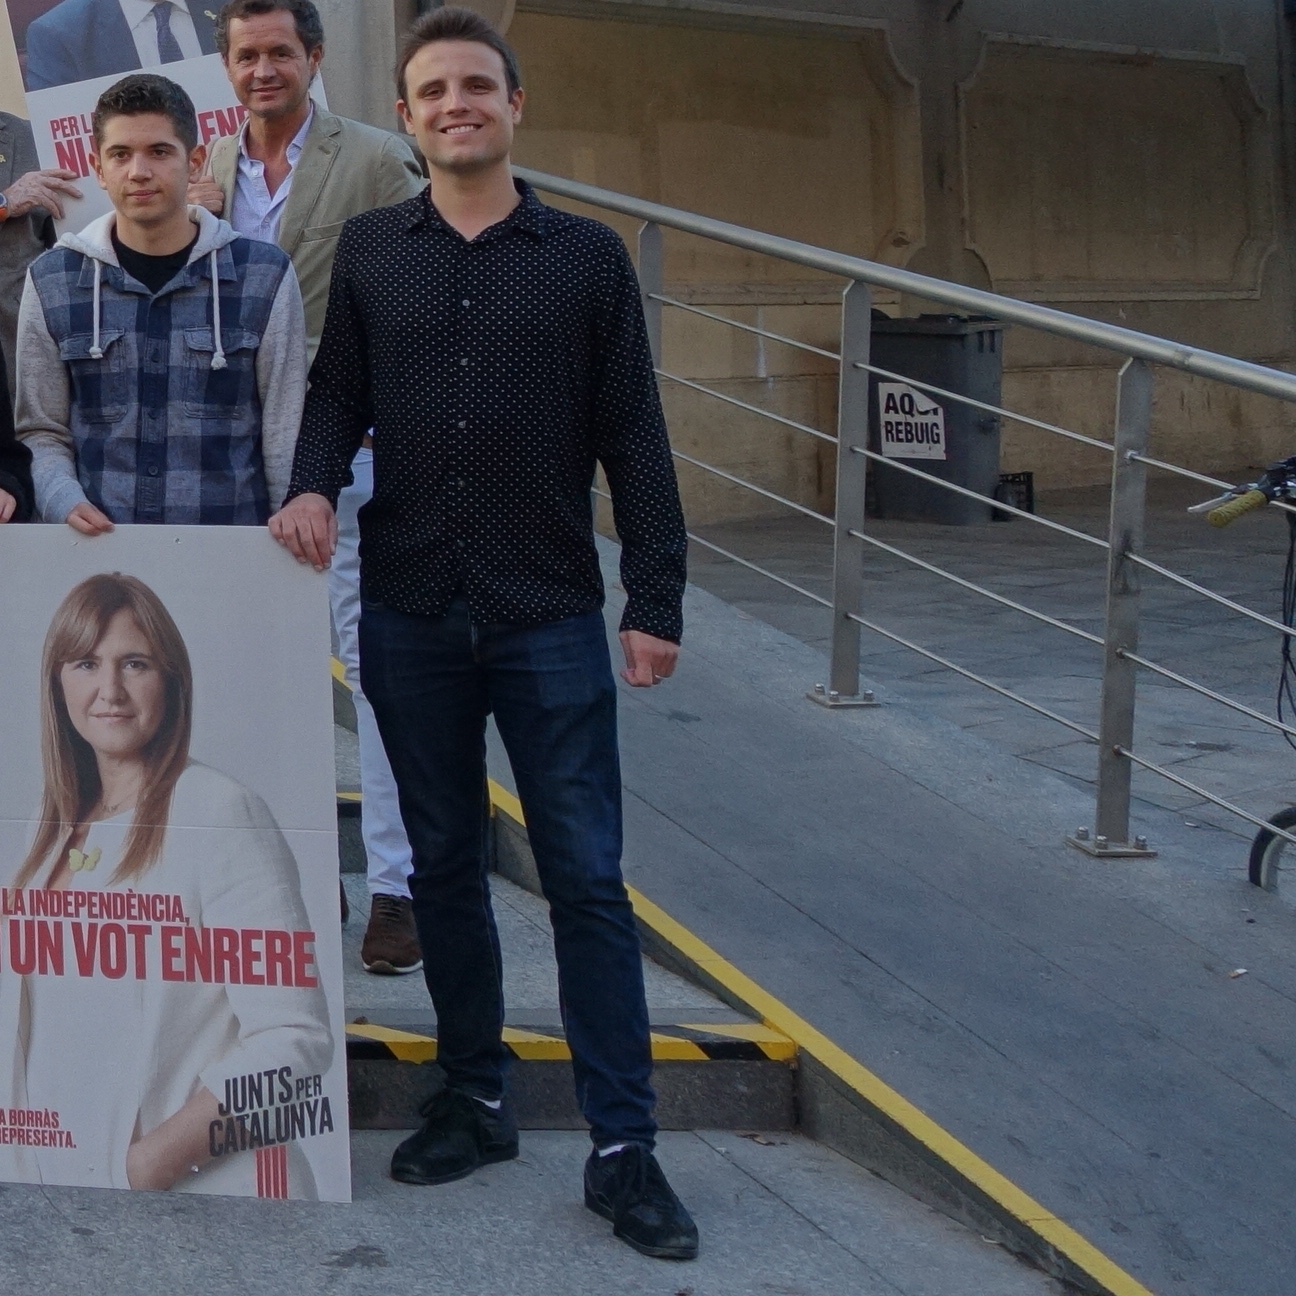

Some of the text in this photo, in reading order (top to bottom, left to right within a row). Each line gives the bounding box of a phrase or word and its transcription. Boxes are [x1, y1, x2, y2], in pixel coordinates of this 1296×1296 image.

[49, 115, 80, 140] PER
[54, 137, 90, 178] NI
[885, 392, 939, 418] AQ
[885, 421, 941, 444] REBUIG
[2, 888, 26, 916] LA
[29, 888, 190, 925] INDEPENDÈNCIA,
[9, 919, 65, 976] UN
[71, 922, 152, 980] VOT
[160, 926, 318, 989] ENRERE
[218, 1065, 322, 1117] JUNTS PER
[8, 1108, 59, 1129] BORRÀS
[209, 1096, 334, 1157] CATALUNYA
